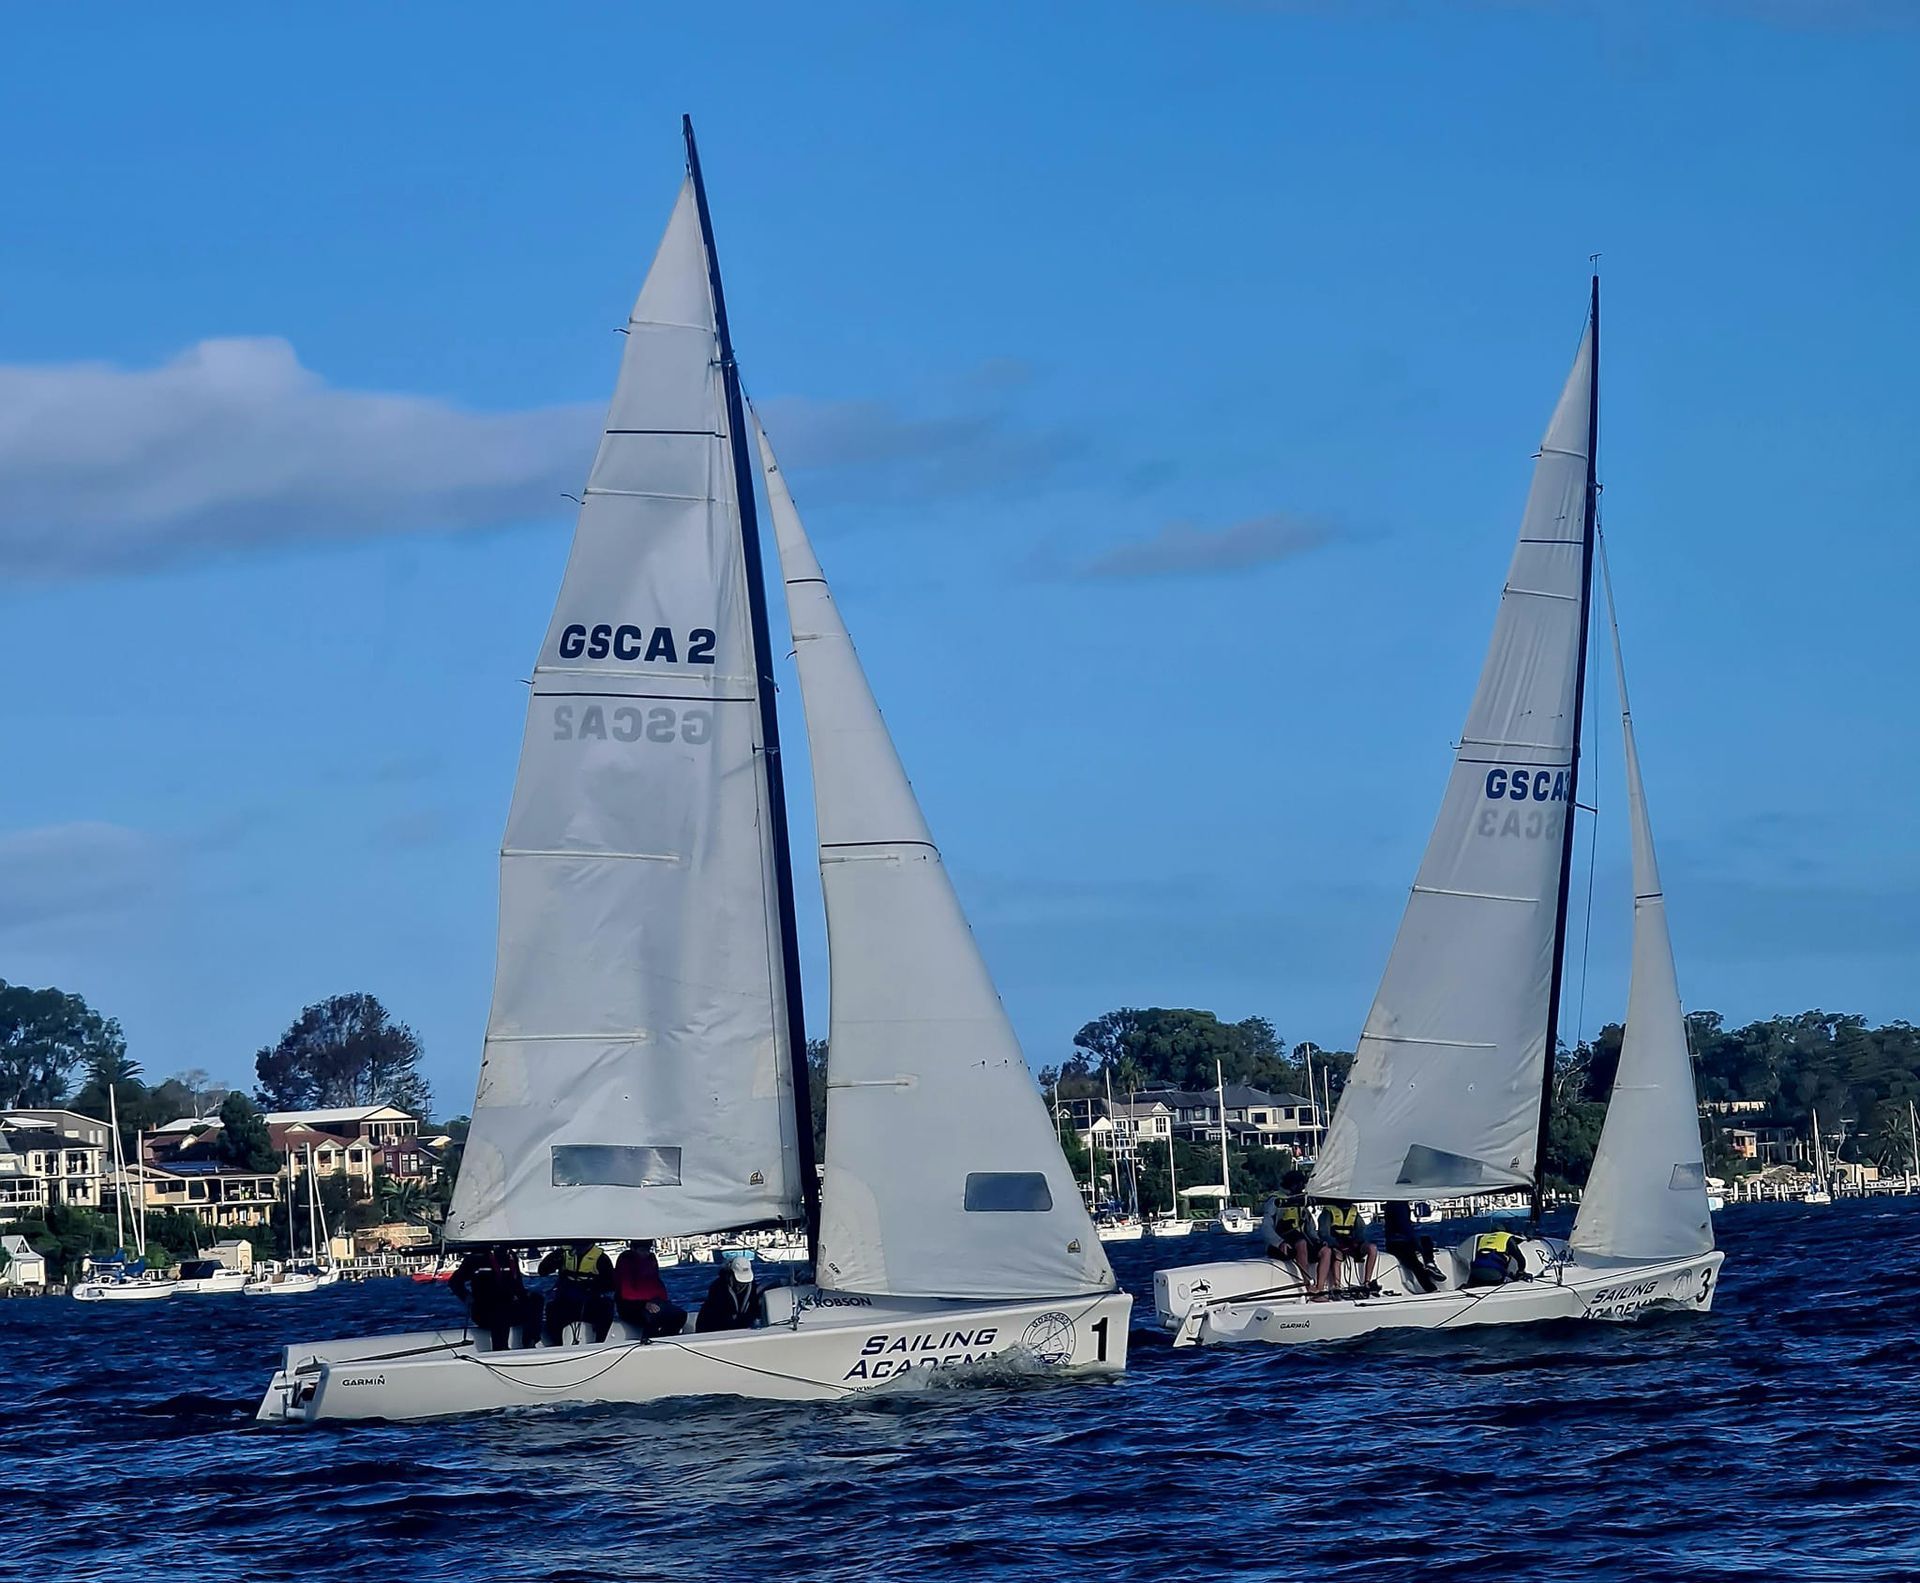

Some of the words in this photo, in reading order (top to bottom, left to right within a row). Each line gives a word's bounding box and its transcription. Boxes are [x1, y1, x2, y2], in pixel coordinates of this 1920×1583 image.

[559, 624, 678, 663] GSCA
[687, 629, 716, 664] 2
[1591, 1280, 1659, 1305] SAILING
[1696, 1267, 1712, 1303] 3
[815, 1297, 872, 1308] ROBSON
[1581, 1300, 1655, 1319] ACADEM
[1280, 1321, 1310, 1329] GARMIN
[861, 1328, 998, 1356] SAILING
[1091, 1316, 1108, 1362] 1
[843, 1351, 999, 1381] ACADEM
[342, 1376, 385, 1386] GARMIN
